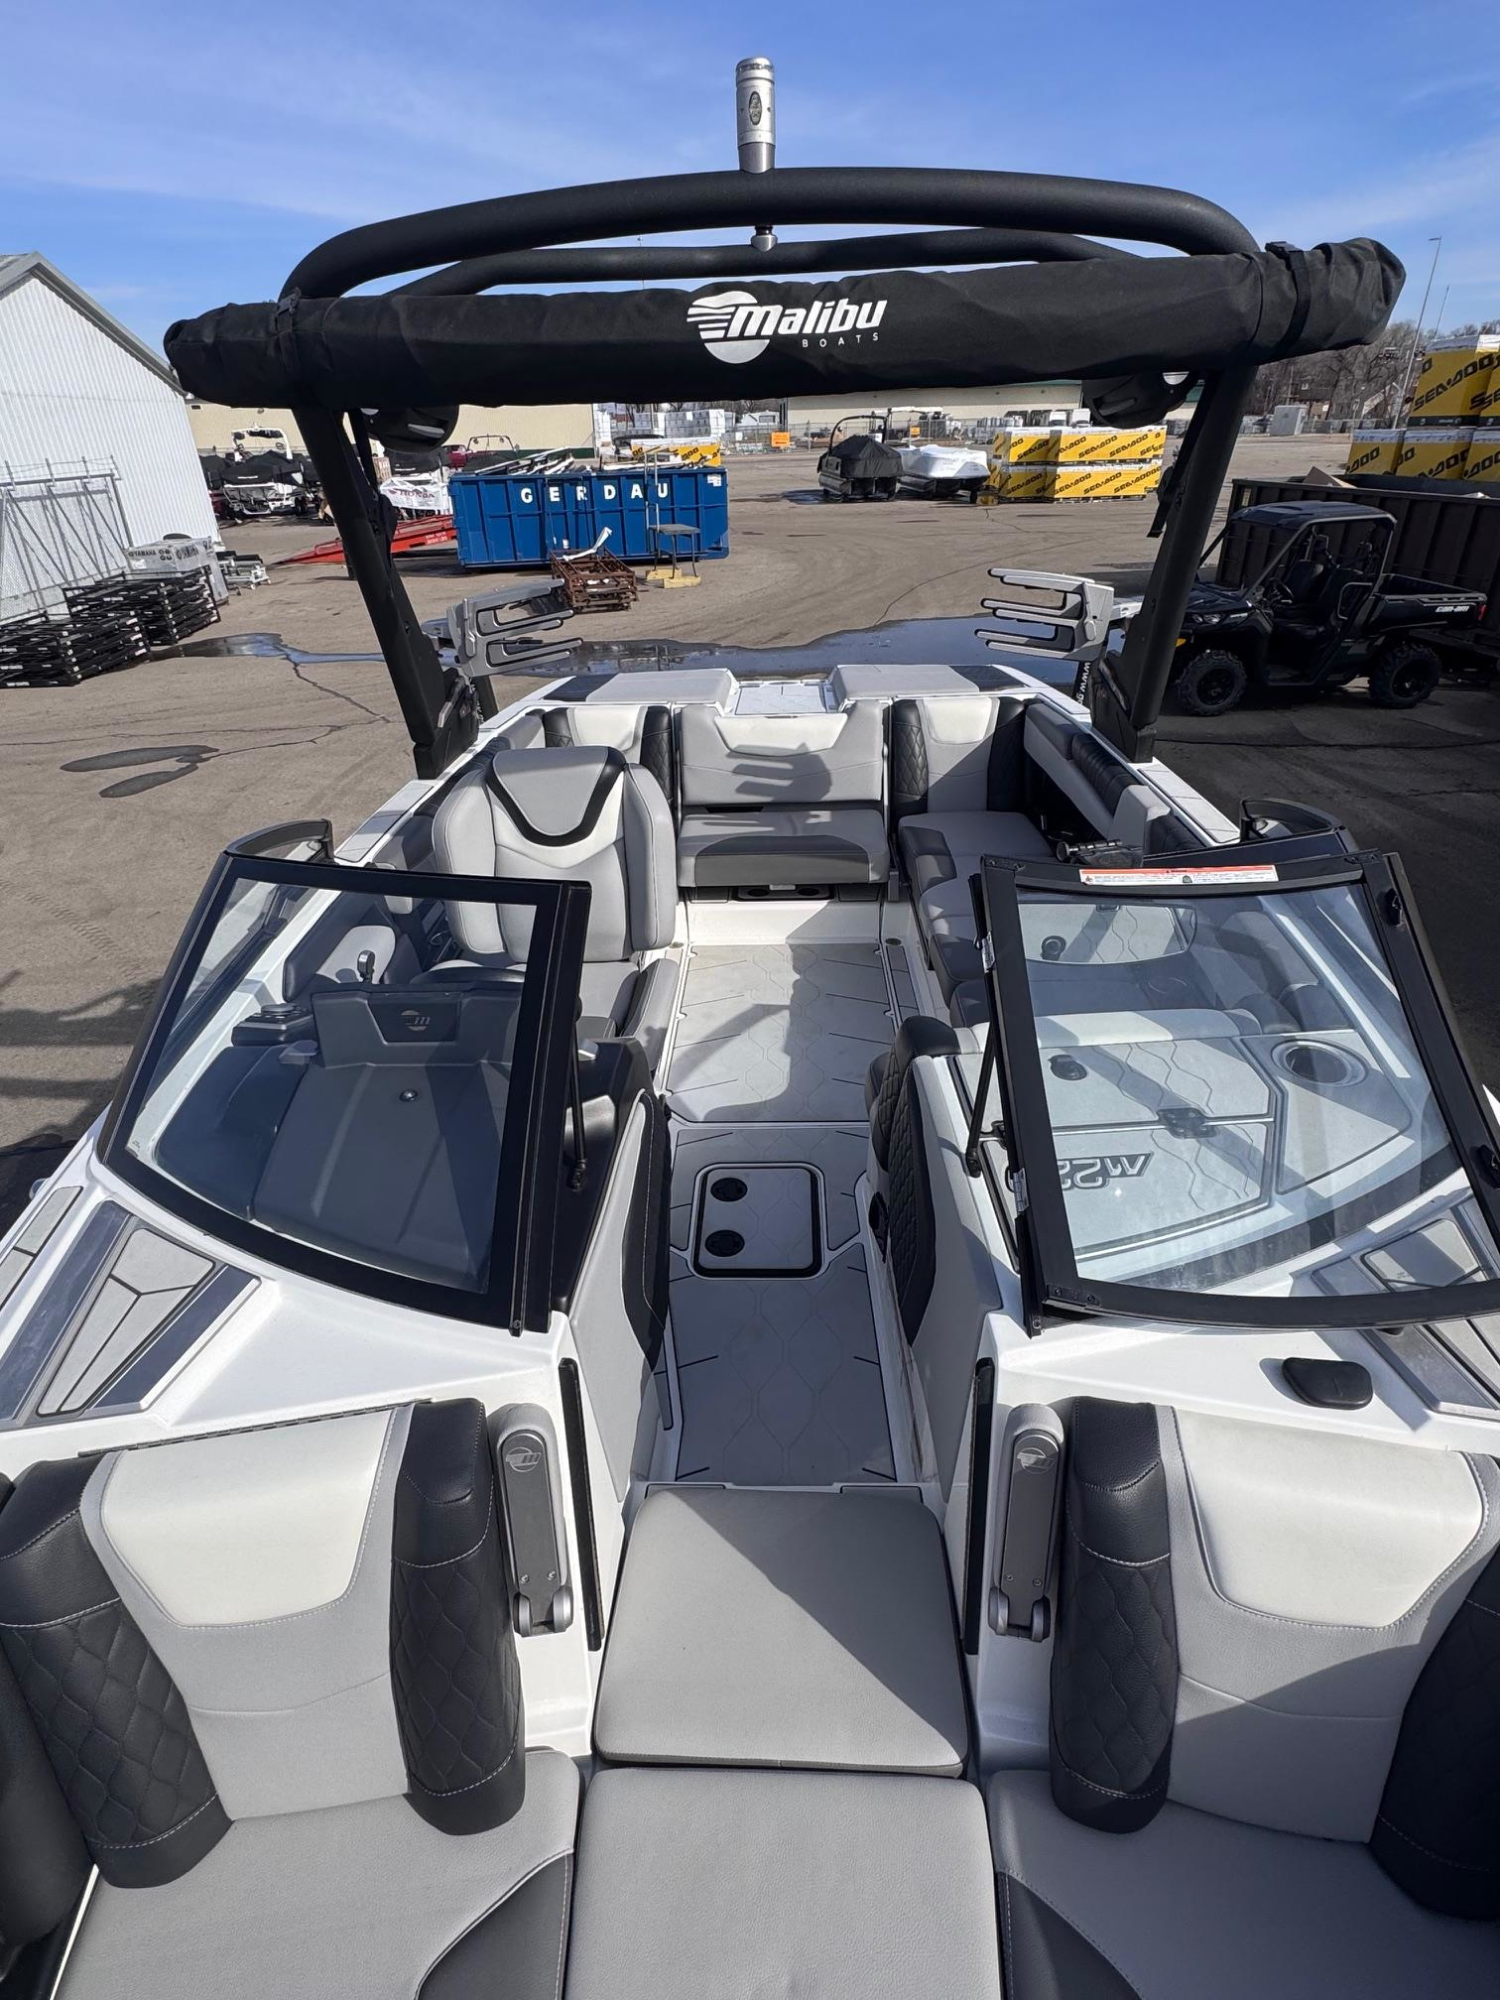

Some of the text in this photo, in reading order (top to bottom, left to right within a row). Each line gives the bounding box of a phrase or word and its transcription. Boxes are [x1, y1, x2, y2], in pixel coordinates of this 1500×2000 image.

[801, 332, 880, 348] BOATS
[399, 489, 436, 499] HONDA
[520, 483, 669, 504] GERDAU
[135, 549, 157, 557] YAMAHA
